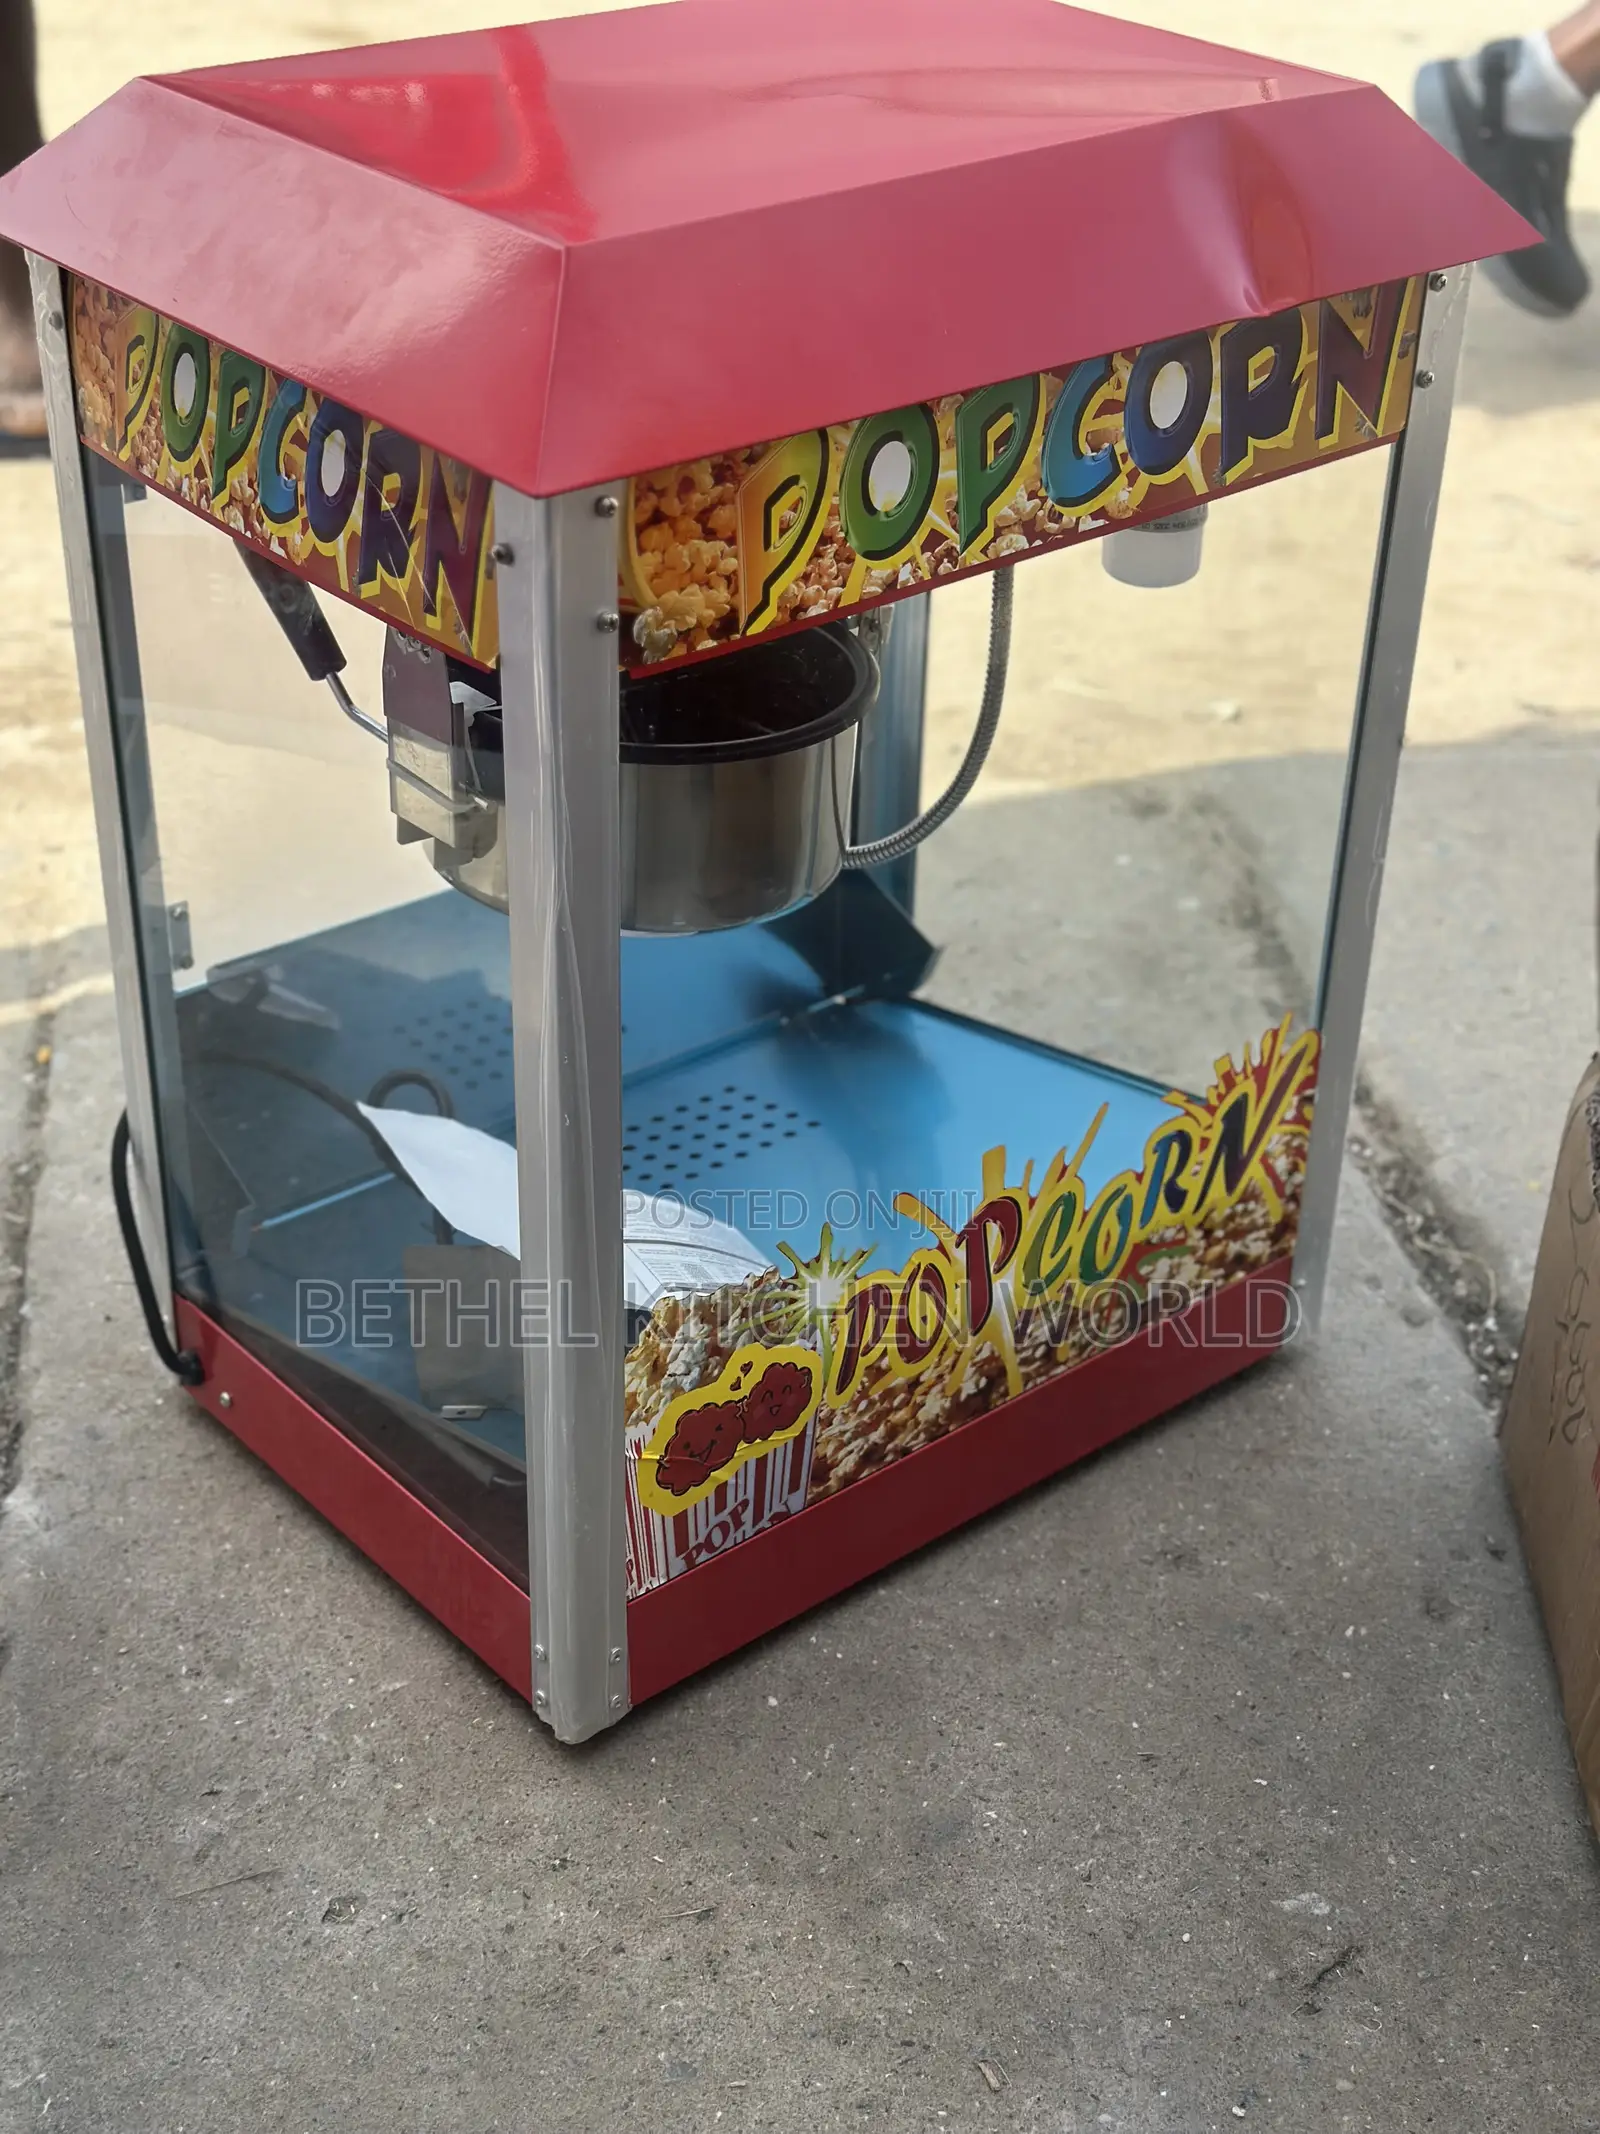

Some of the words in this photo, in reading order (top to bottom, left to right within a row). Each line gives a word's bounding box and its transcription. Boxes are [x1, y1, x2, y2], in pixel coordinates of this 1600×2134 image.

[114, 308, 493, 655] POPCORN
[738, 277, 1418, 636] POPCORN
[832, 1038, 1313, 1398] POPCORN
